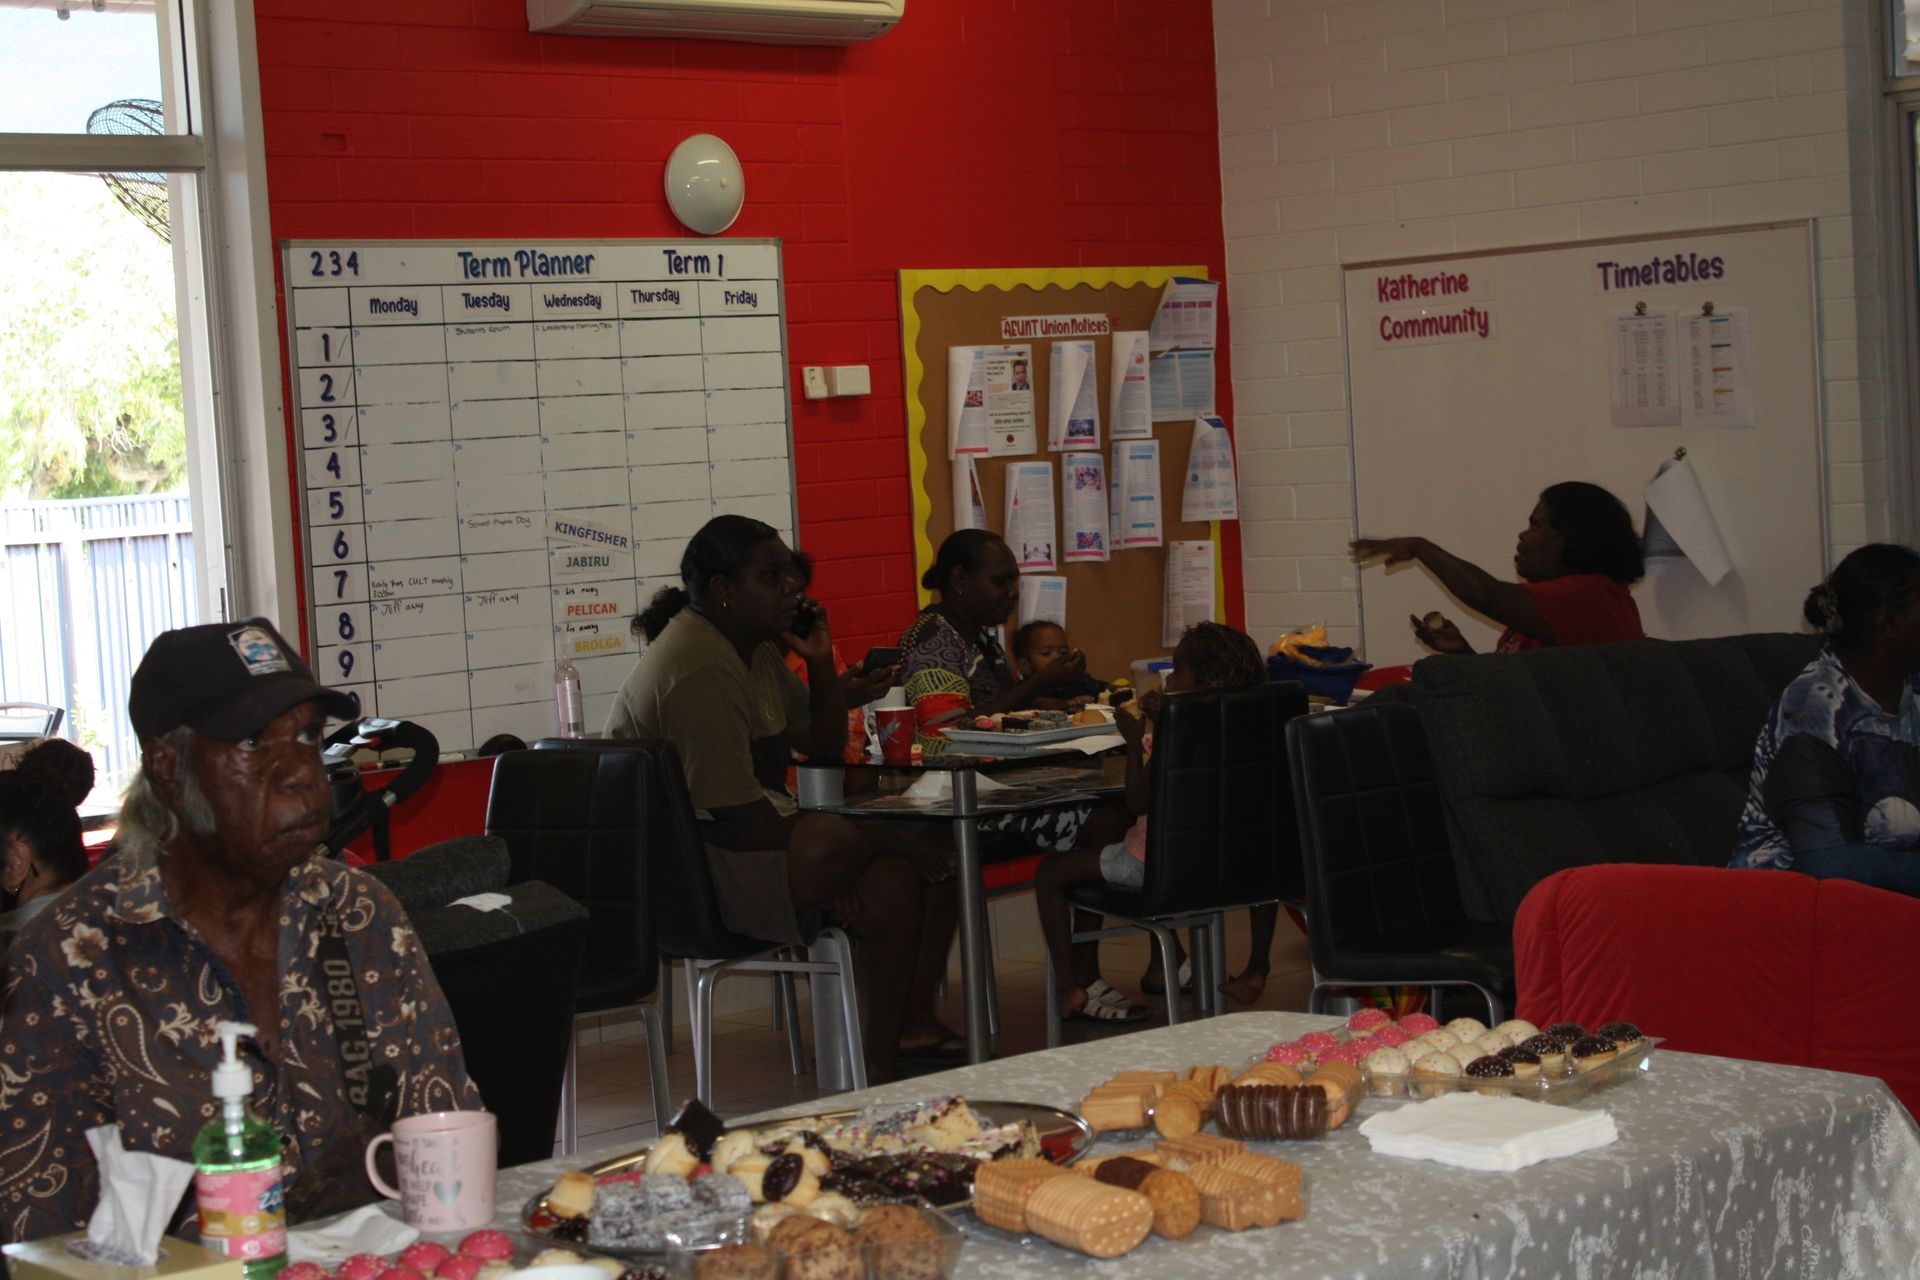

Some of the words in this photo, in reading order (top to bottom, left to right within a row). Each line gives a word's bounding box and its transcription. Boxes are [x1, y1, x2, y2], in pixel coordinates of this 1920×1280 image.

[457, 251, 512, 280] Term
[514, 249, 596, 278] Planner
[663, 249, 711, 276] Term
[717, 253, 725, 278] 1
[1596, 252, 1724, 291] Timetables
[630, 288, 680, 305] Thursday
[724, 290, 758, 308] Friday
[1377, 271, 1469, 303] Katherine
[369, 297, 419, 317] Monday
[461, 292, 510, 312] Tuesday
[543, 293, 602, 310] Wednesday
[1040, 318, 1070, 335] Union
[1071, 318, 1108, 334] Notices
[1379, 306, 1489, 342] Community
[321, 333, 331, 362] 1
[319, 373, 337, 402] 2
[321, 414, 338, 443] 3
[326, 452, 342, 480] 4
[329, 491, 345, 520] 5
[333, 529, 349, 560] 6
[555, 521, 628, 549] KINGFISHER
[566, 556, 610, 568] JABIRU
[333, 570, 349, 600] 7
[567, 602, 617, 617] PELICAN
[339, 612, 355, 640] 8
[575, 637, 622, 652] BROLGA
[338, 650, 354, 678] 9
